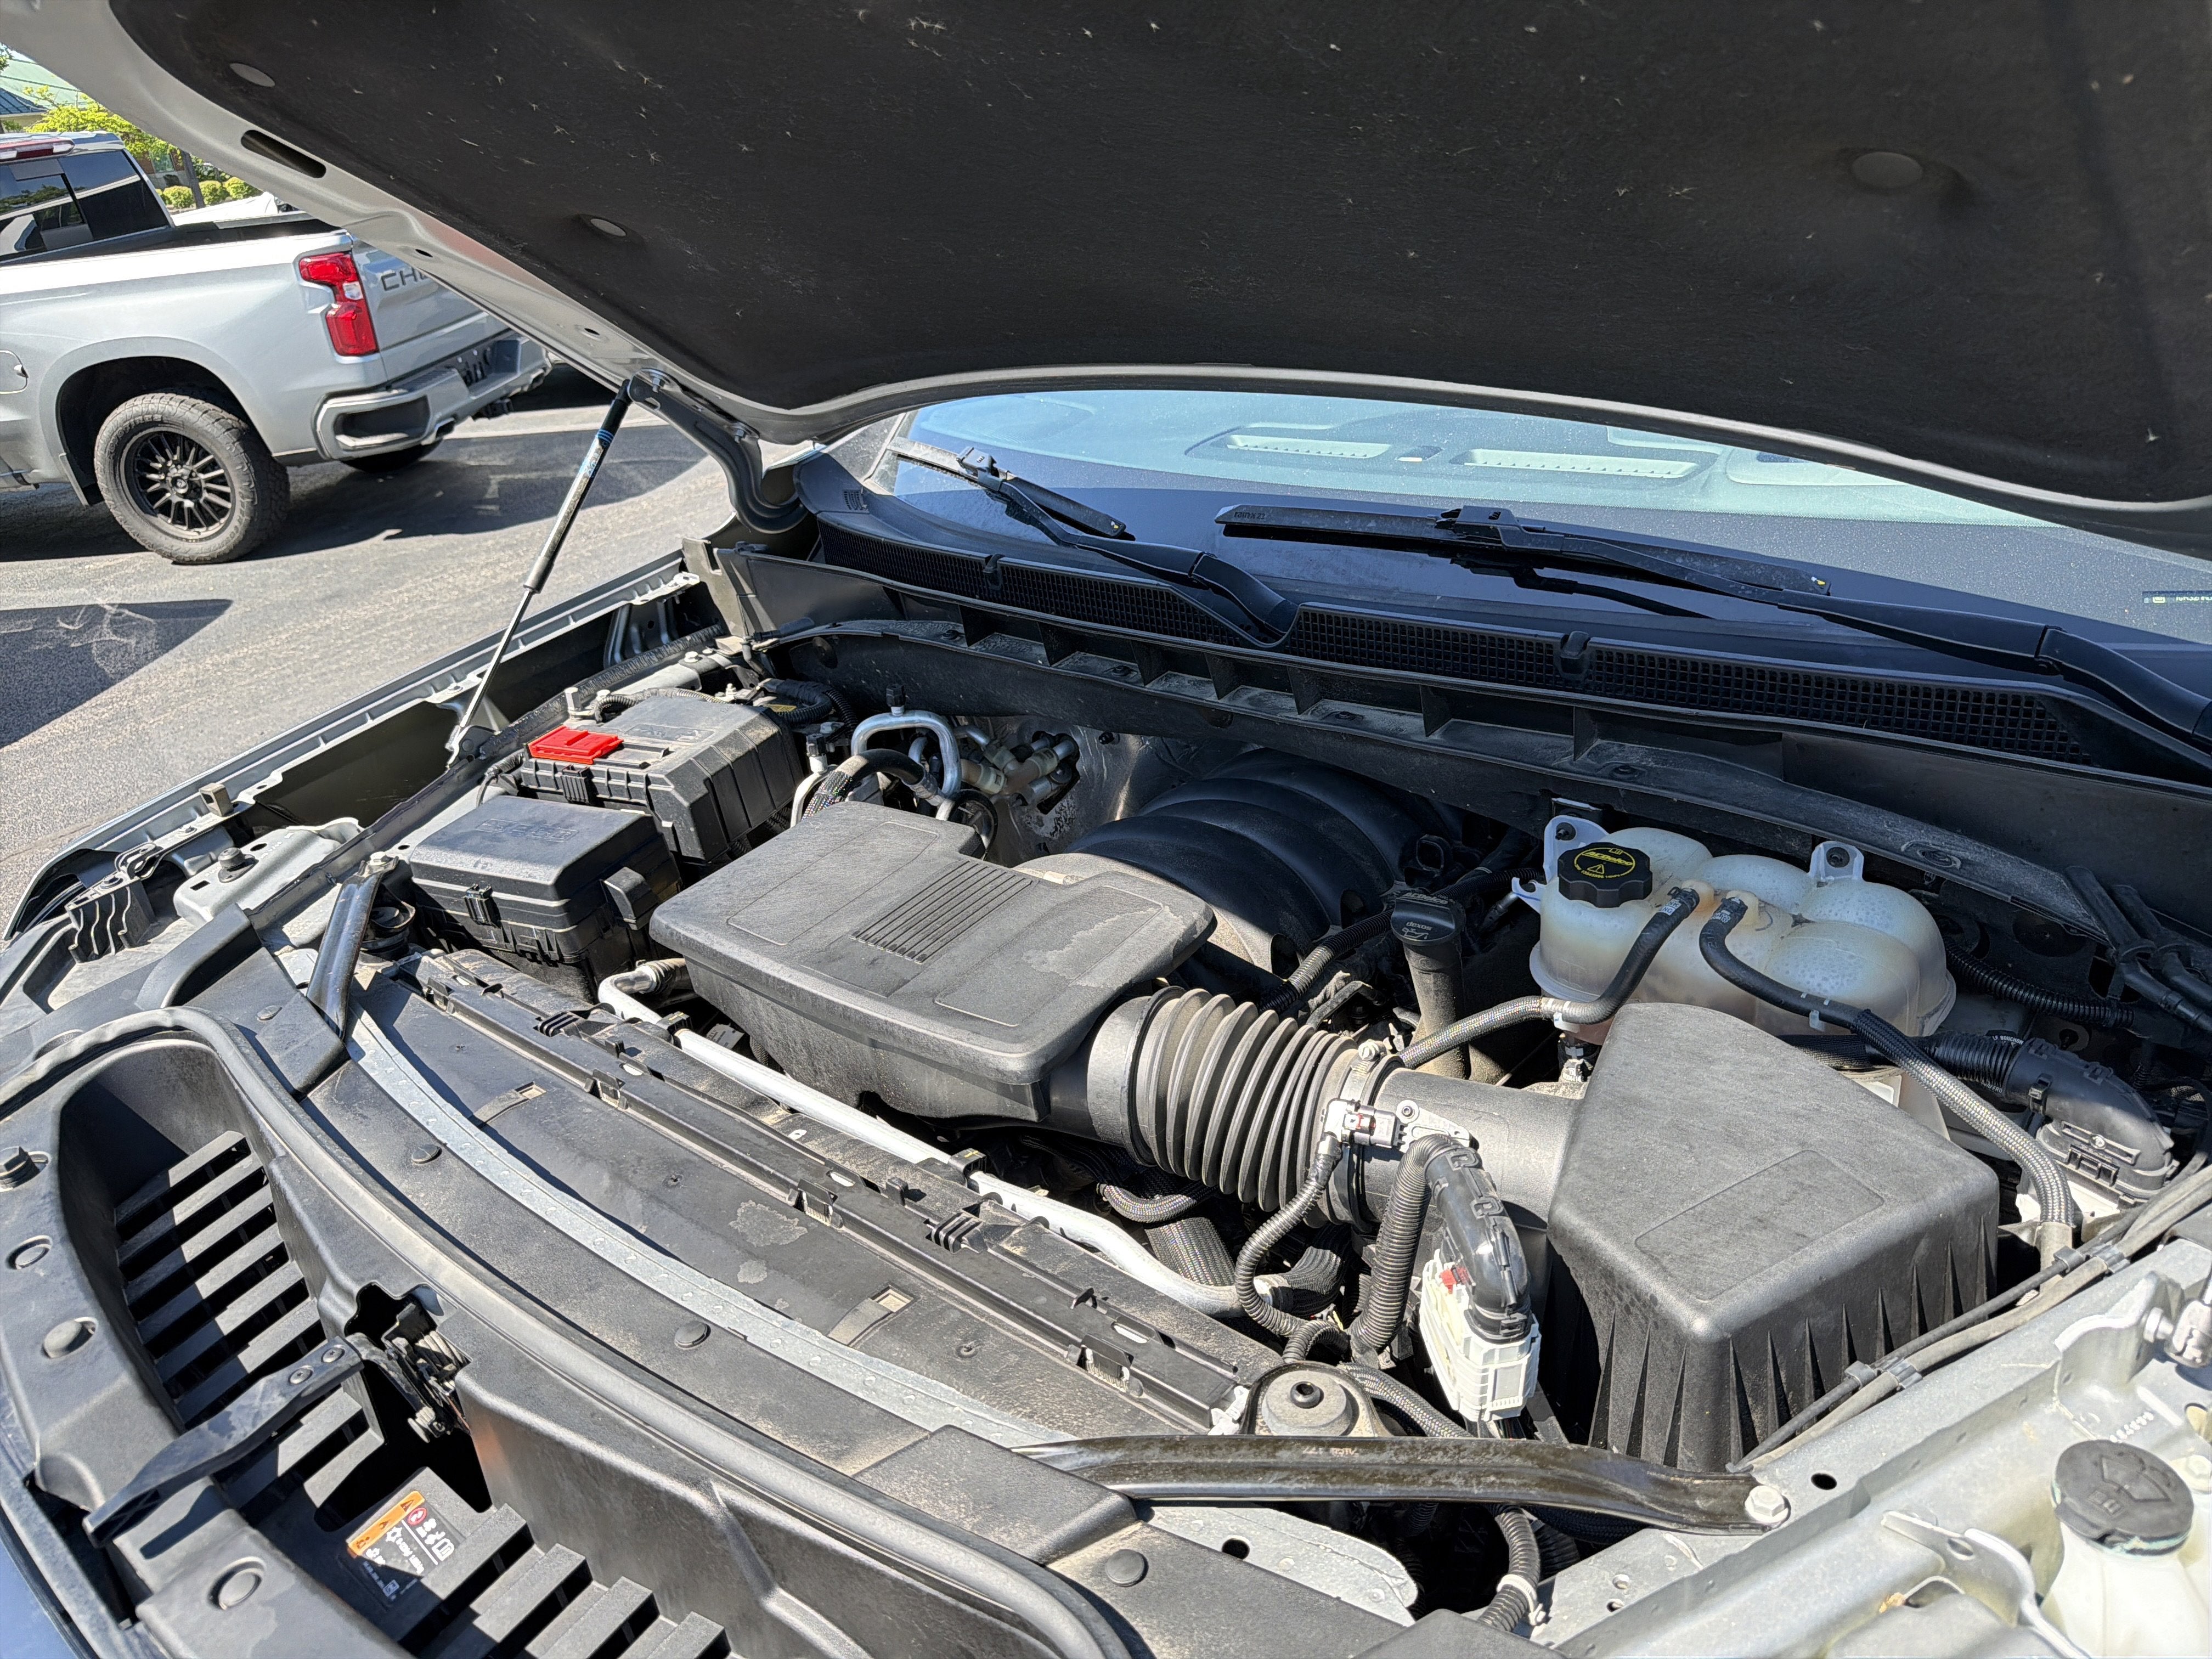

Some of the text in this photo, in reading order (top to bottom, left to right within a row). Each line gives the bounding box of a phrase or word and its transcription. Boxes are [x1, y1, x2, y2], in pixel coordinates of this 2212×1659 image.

[1584, 851, 1633, 866] ACDelco
[1402, 892, 1448, 905] ACDelco
[1406, 921, 1432, 931] dexos
[2000, 1035, 2024, 1045] BOUCHON
